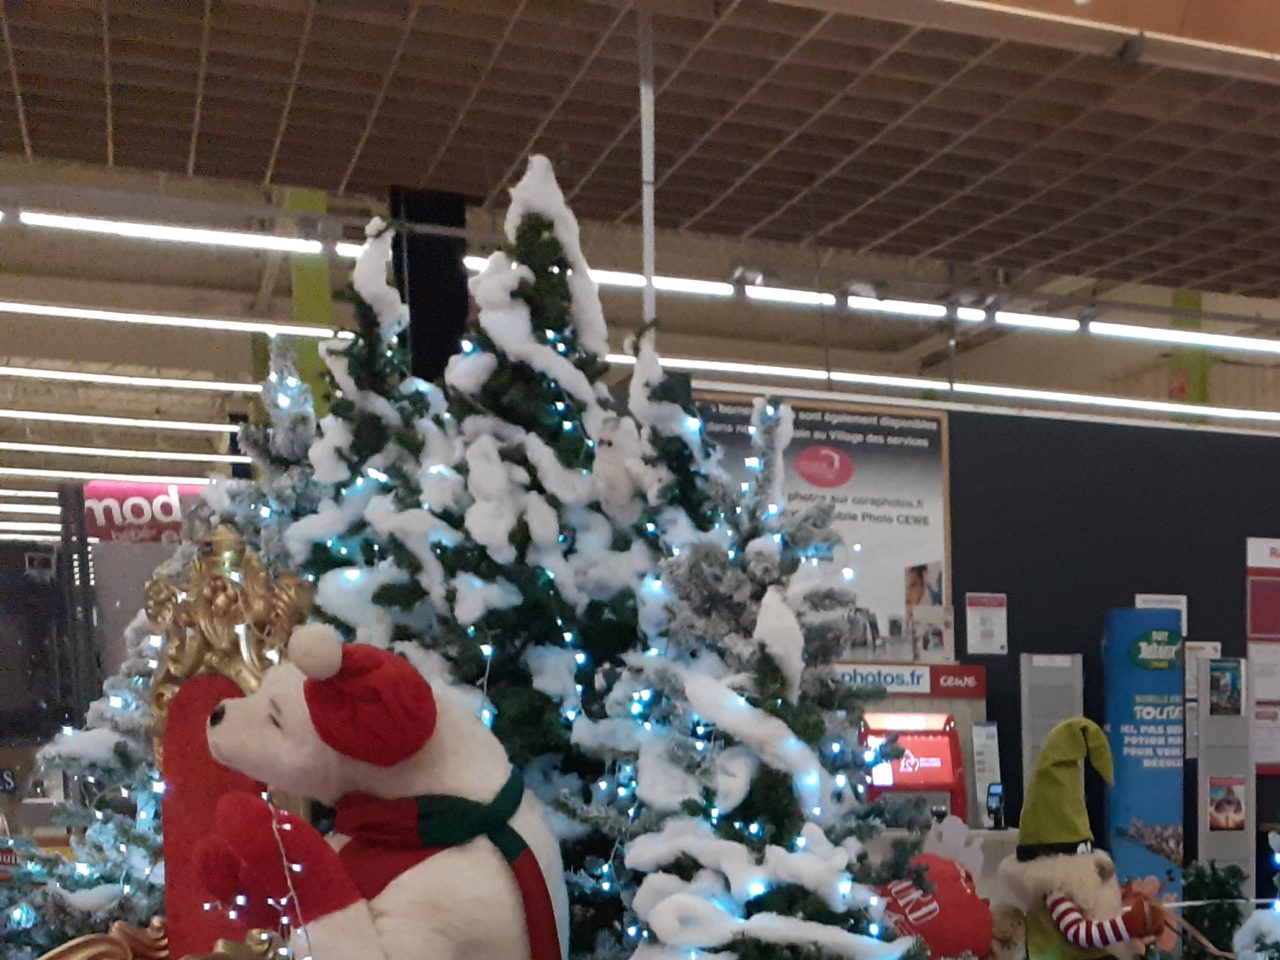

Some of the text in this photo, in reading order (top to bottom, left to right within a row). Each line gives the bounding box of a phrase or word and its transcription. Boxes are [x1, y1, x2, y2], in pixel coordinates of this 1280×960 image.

[861, 511, 894, 524] Photo
[896, 514, 929, 526] CEWE
[840, 668, 923, 686] photos.fr
